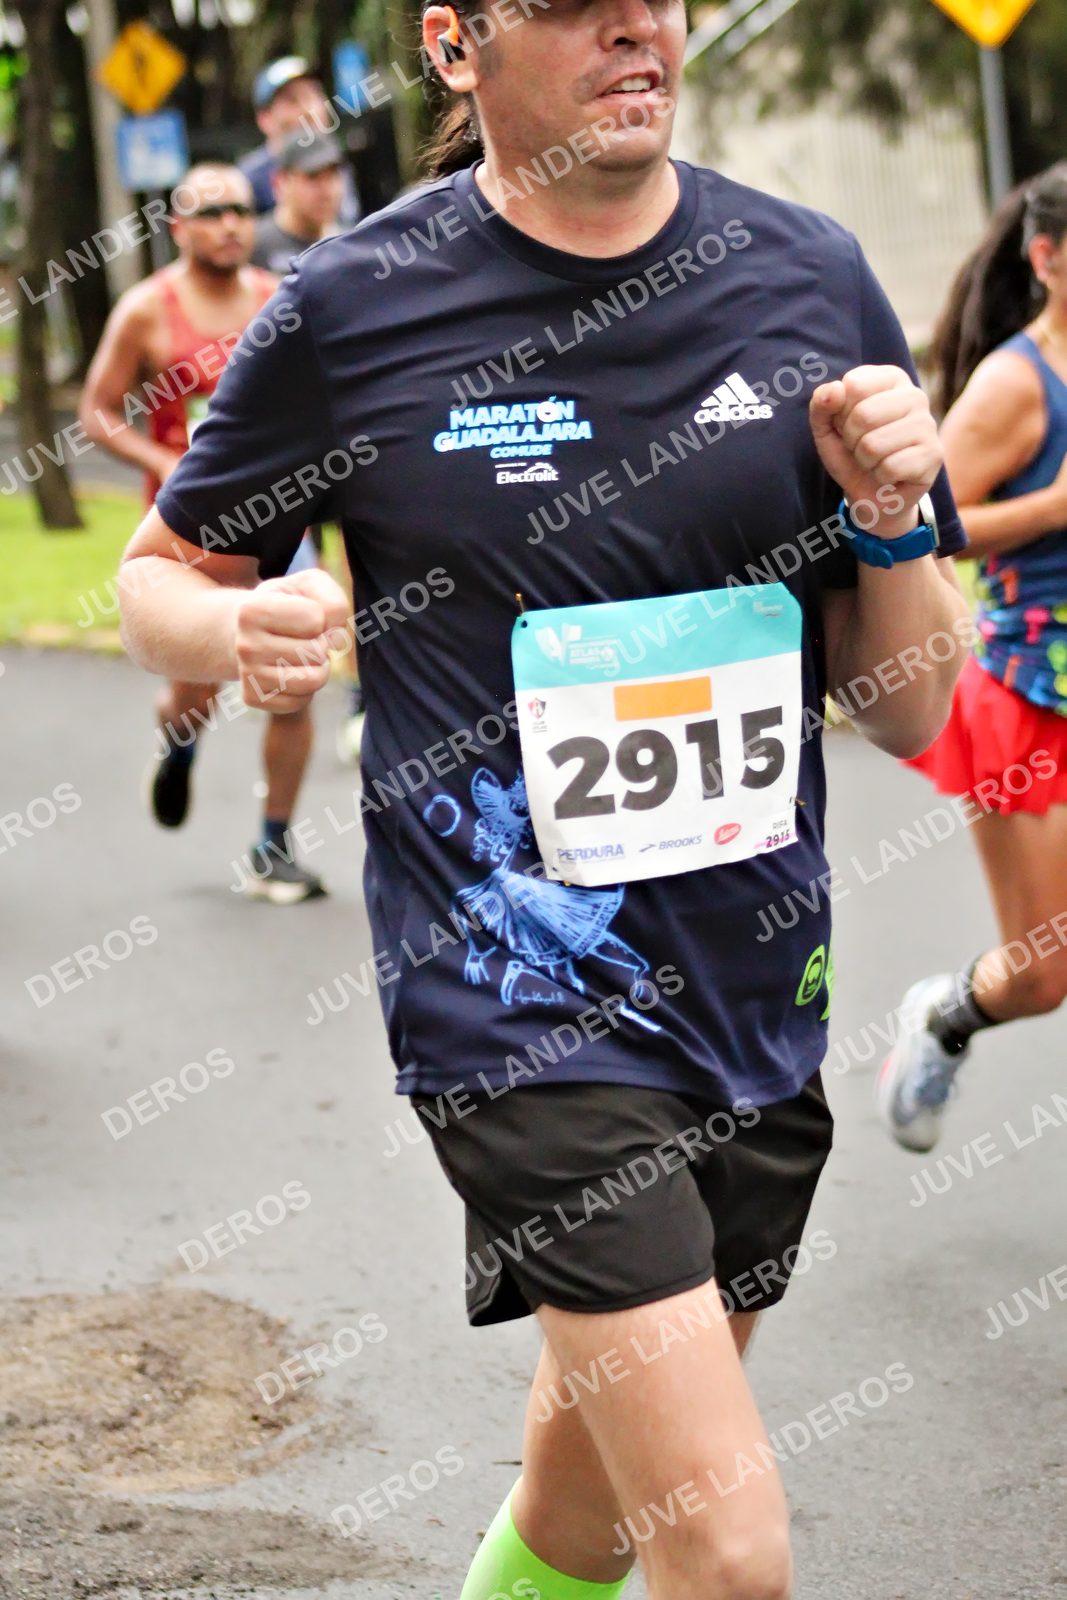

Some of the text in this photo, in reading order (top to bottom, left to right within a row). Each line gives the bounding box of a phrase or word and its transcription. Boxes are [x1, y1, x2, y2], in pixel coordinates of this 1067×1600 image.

[450, 396, 575, 430] MARATÓN
[694, 403, 773, 424] adidas
[433, 421, 592, 452] GUADALAJARA
[490, 444, 553, 459] COMUDE
[496, 469, 560, 485] Electrolit
[546, 705, 786, 820] 2915
[556, 835, 703, 861] PERDURA BROOKS
[766, 829, 790, 848] 2915
